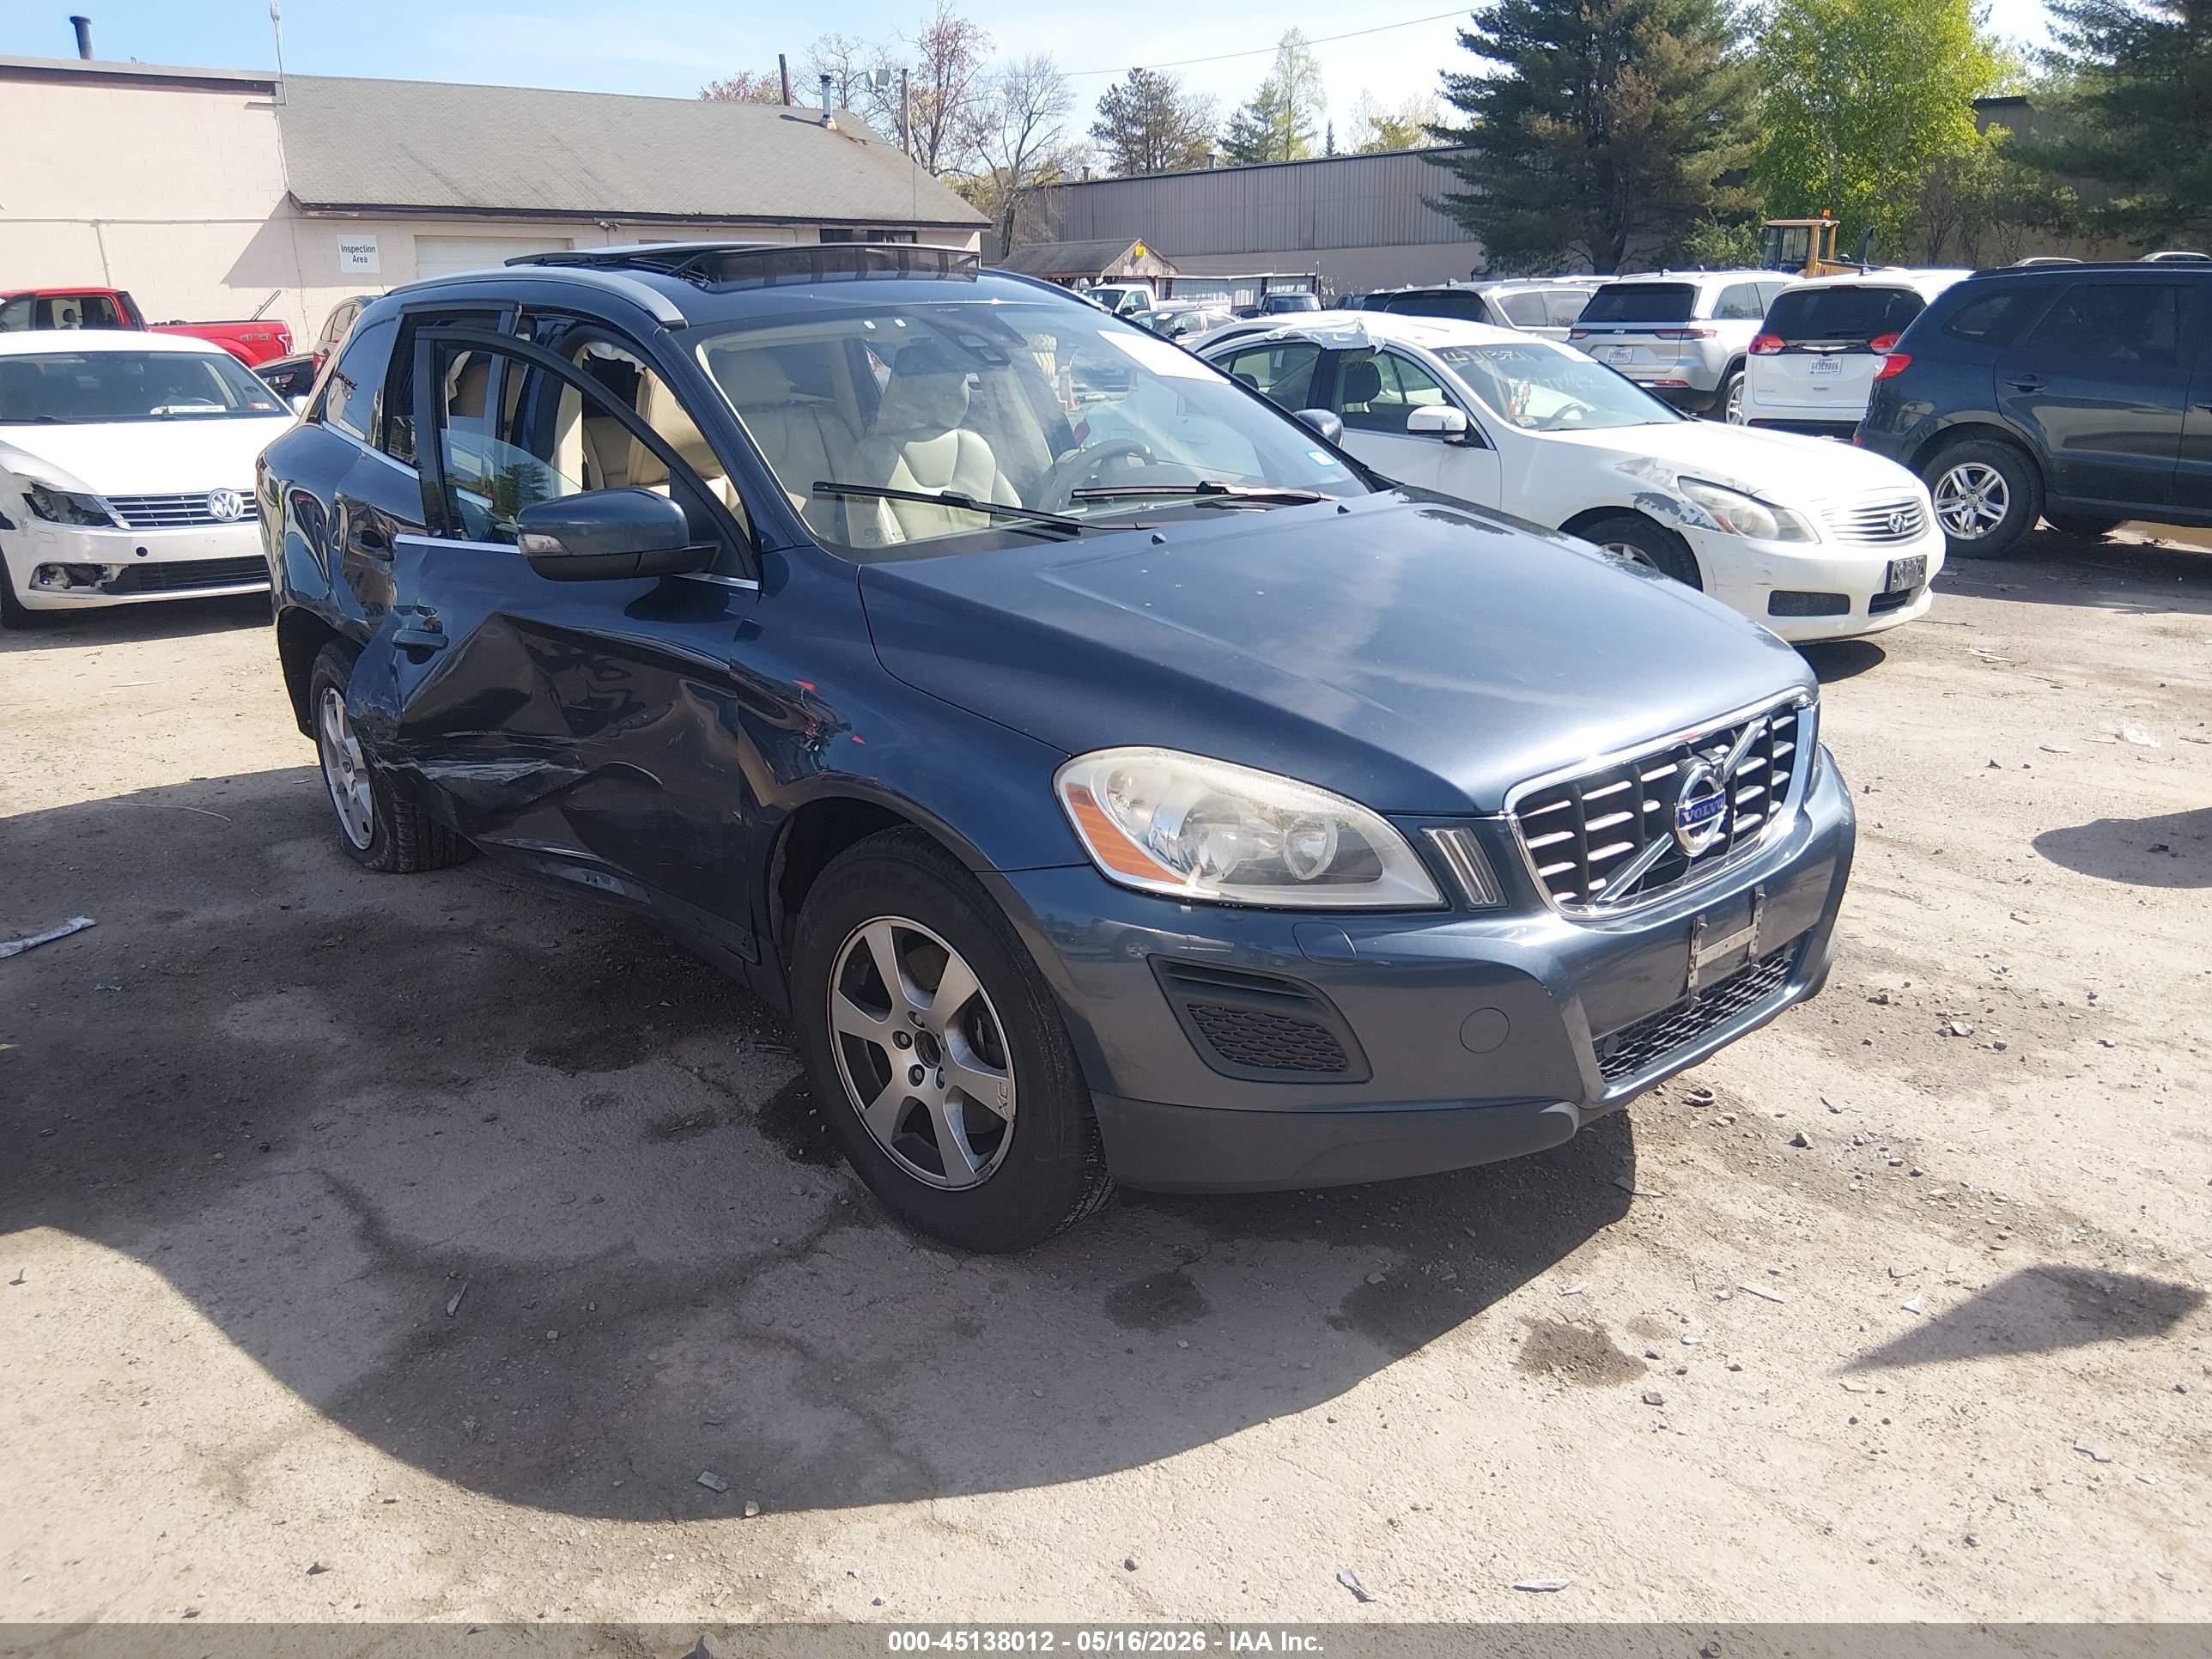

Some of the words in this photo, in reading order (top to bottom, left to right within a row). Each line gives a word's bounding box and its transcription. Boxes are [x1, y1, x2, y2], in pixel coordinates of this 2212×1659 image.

[341, 244, 376, 254] Inspection
[352, 254, 368, 264] Area
[1681, 798, 1723, 823] VOLVO
